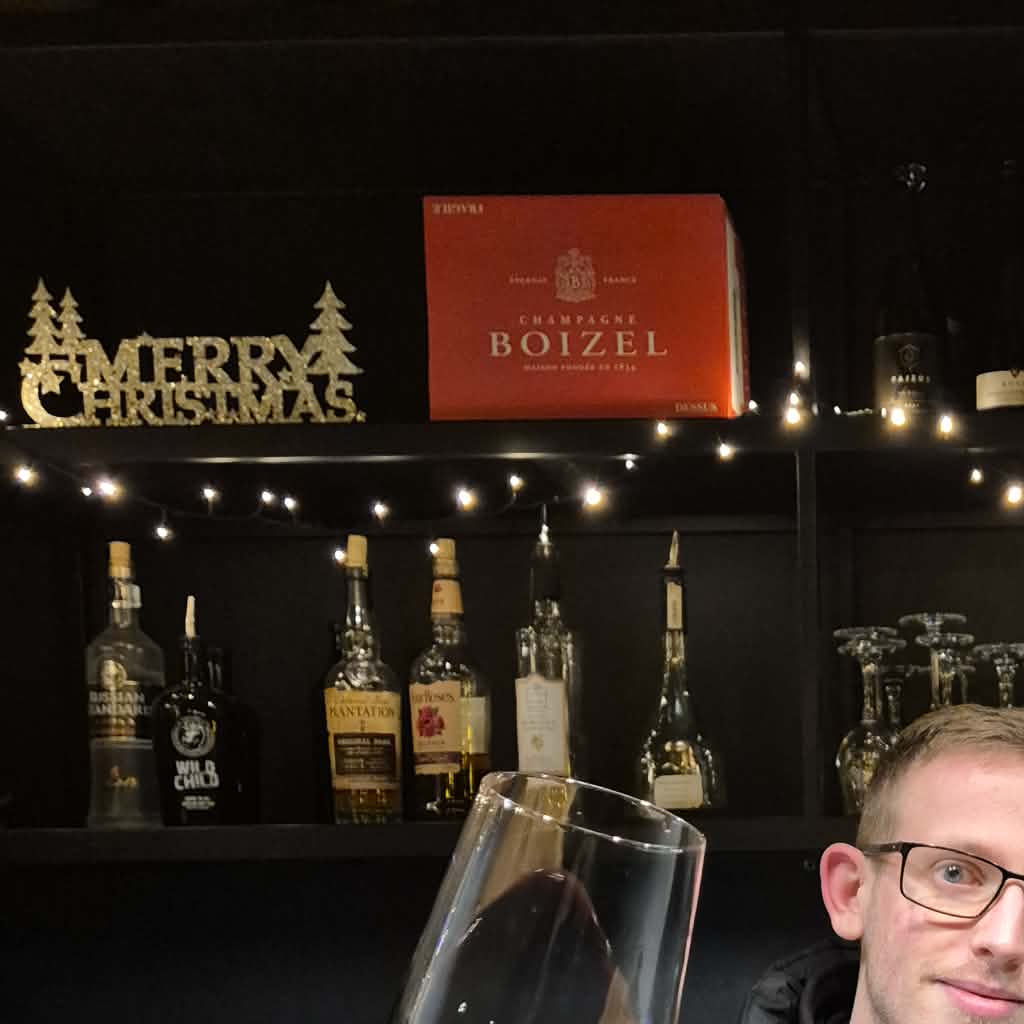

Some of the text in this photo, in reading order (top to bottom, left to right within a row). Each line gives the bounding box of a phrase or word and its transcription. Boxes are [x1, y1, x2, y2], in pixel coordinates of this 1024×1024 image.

[519, 314, 637, 325] CHAMPAGNE
[488, 331, 669, 357] BOIZEL
[82, 335, 322, 387] MERRY
[20, 368, 358, 428] CHRISTMAS
[175, 759, 217, 775] WILD
[174, 772, 220, 791] CHILD
